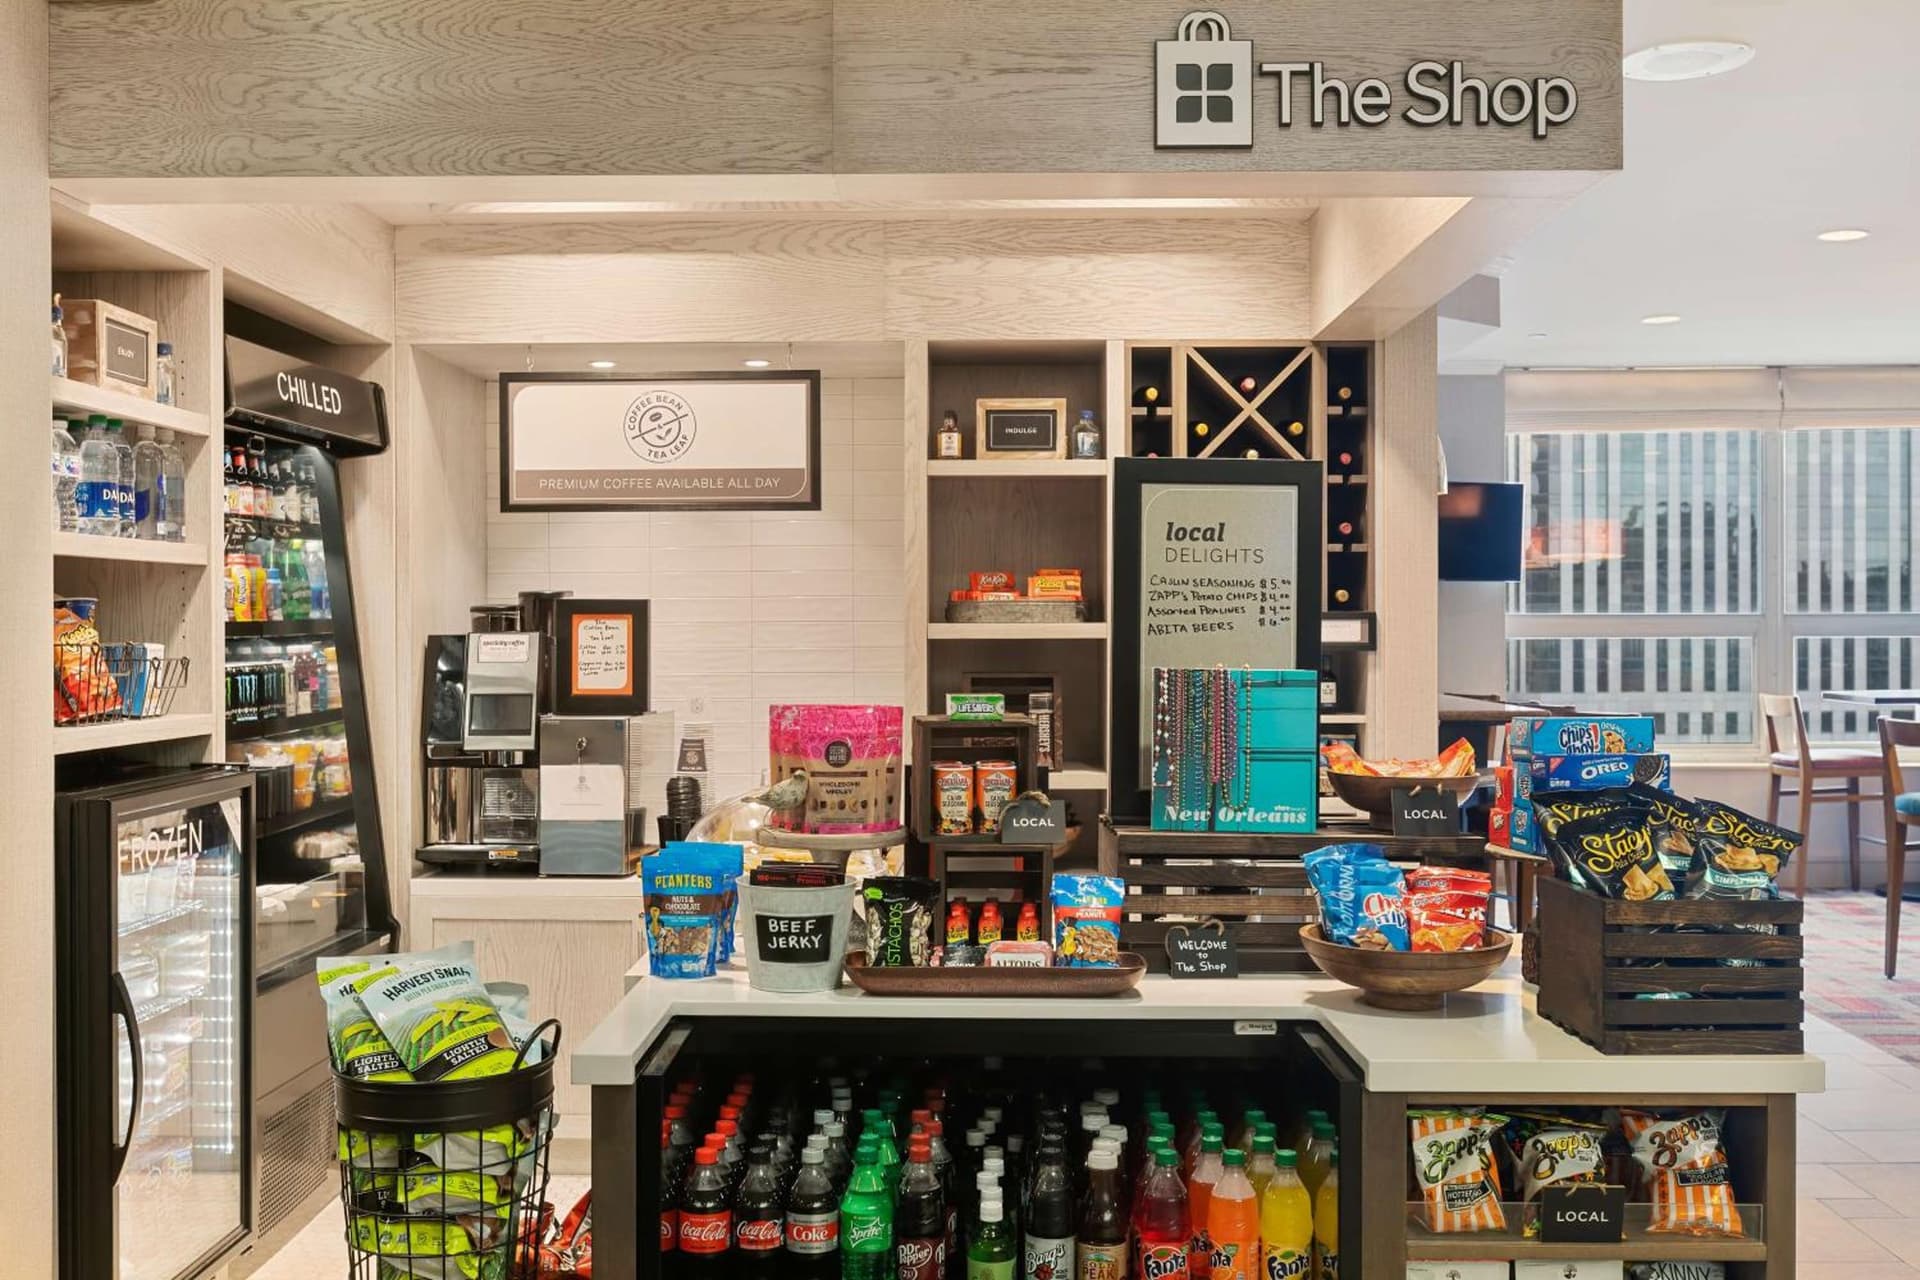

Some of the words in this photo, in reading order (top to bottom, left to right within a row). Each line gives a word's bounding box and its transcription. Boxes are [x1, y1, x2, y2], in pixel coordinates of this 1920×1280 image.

[1261, 61, 1392, 127] The
[1402, 60, 1578, 139] Shop
[277, 371, 342, 415] CHILLED
[628, 396, 652, 431] COFFEE
[655, 394, 683, 411] BEAN
[647, 448, 667, 459] TEA
[669, 433, 689, 456] LEAF
[539, 478, 599, 490] PREMIUM
[603, 477, 653, 490] COFFEE
[656, 477, 724, 489] AVAILABLE
[727, 477, 752, 489] ALL
[755, 477, 780, 489] DAY
[1166, 522, 1226, 542] local
[1165, 547, 1265, 564] DELIGHTS
[1192, 578, 1256, 589] SEASONING
[1226, 592, 1258, 601] CHIPS
[1147, 623, 1189, 636] ABITA
[1192, 621, 1235, 632] BEERS
[1560, 726, 1593, 748] Chips
[1581, 761, 1629, 780] OREO
[1013, 818, 1055, 827] LOCAL
[1163, 805, 1212, 822] New
[1217, 806, 1307, 824] Orleans
[1404, 809, 1448, 819] LOCAL
[117, 819, 203, 875] FROZEN
[655, 873, 713, 889] PLANTERS
[665, 903, 700, 911] CHOCOLATE
[1363, 892, 1402, 918] Che
[768, 918, 817, 934] BEEF
[767, 934, 823, 949] JERKY
[1177, 939, 1228, 951] WELCOME
[1196, 951, 1209, 959] to
[1174, 961, 1197, 973] The
[1199, 961, 1227, 973] Shop
[382, 969, 436, 1001] HARVEST
[442, 1036, 488, 1061] LIGHTLY
[450, 1043, 490, 1067] SALTED
[357, 1060, 399, 1074] SALTED
[1556, 1211, 1608, 1222] LOCAL
[680, 1220, 727, 1241] Coca-Cola
[792, 1225, 829, 1242] Coke
[850, 1226, 882, 1240] Sprite
[1026, 1243, 1066, 1274] Barq's
[1647, 1261, 1711, 1280] SKINNY
